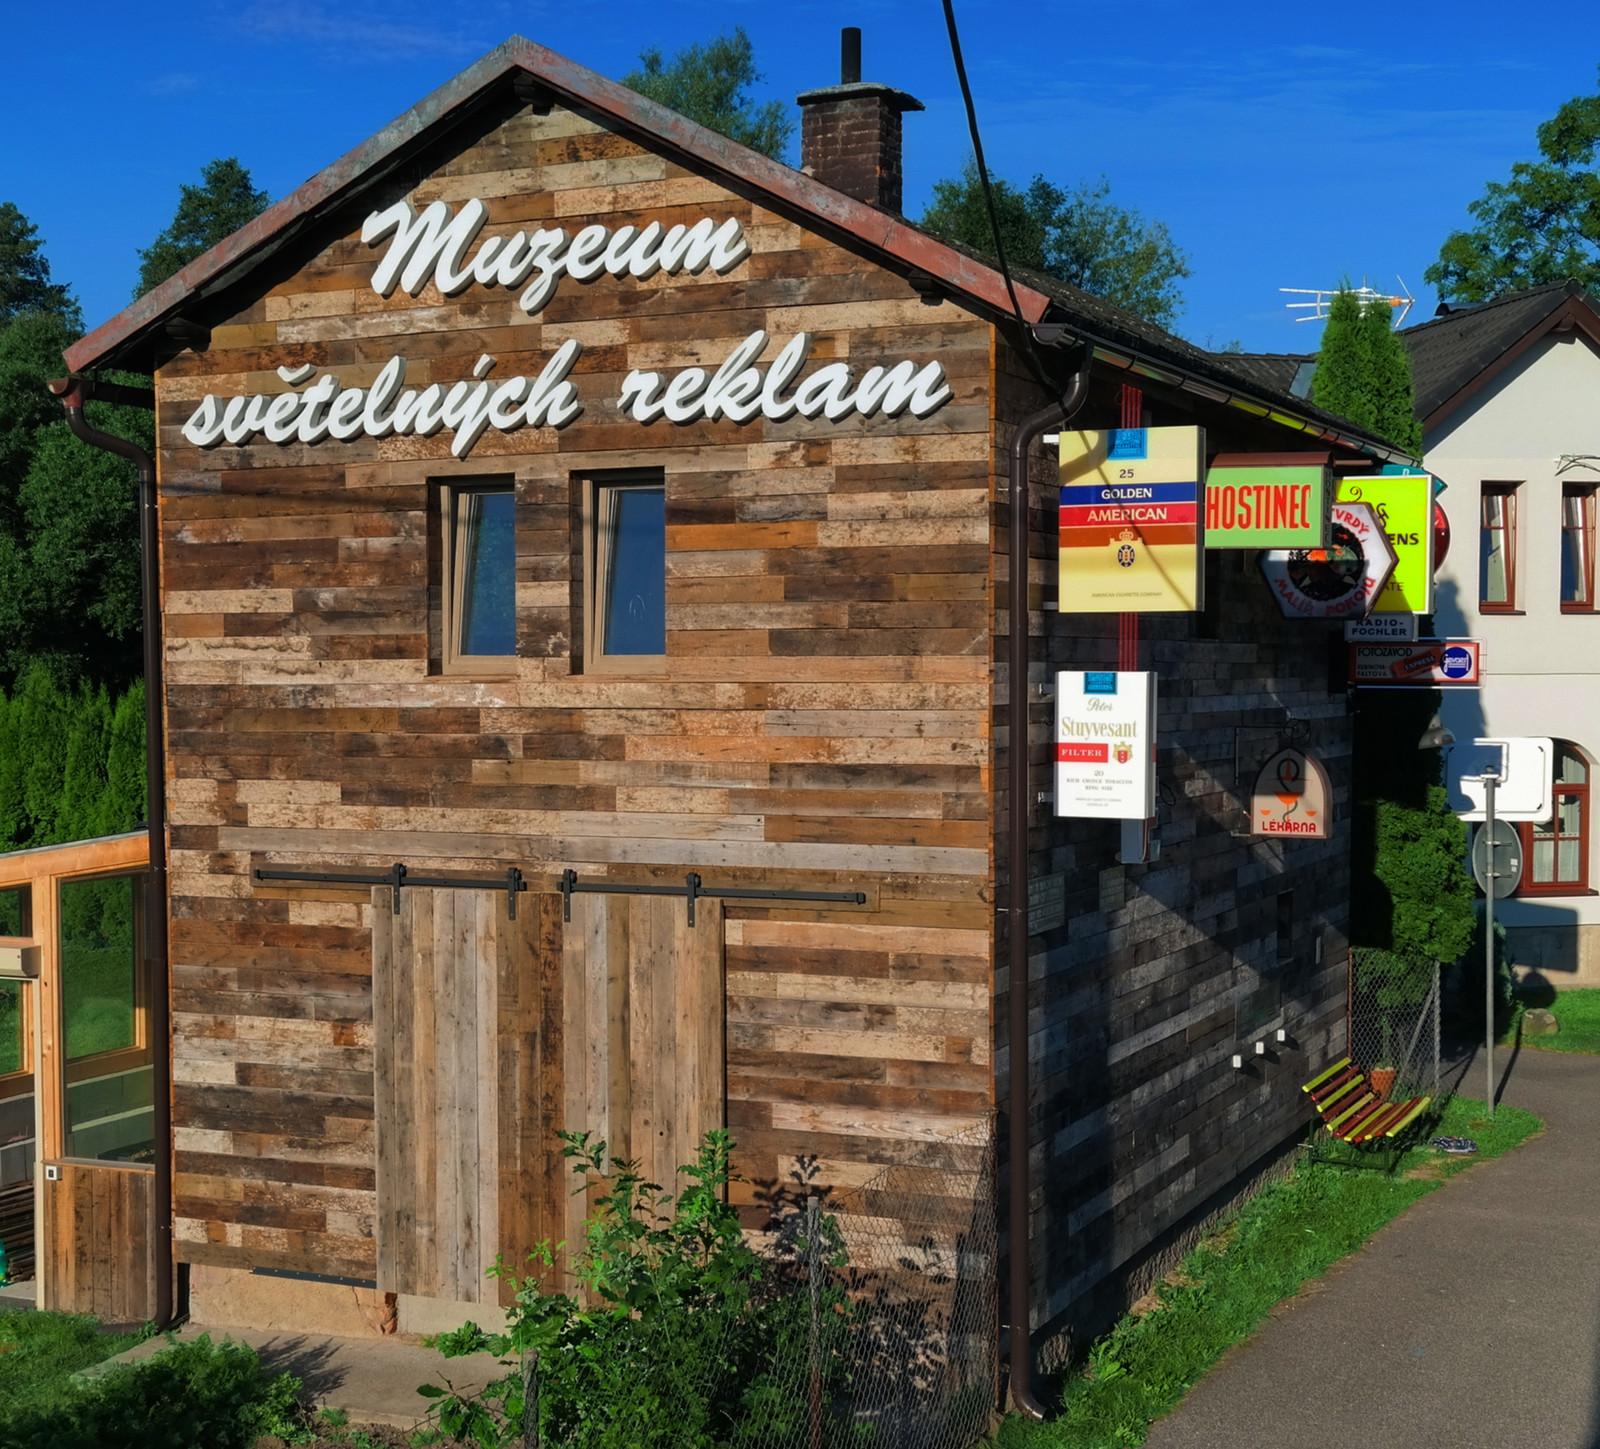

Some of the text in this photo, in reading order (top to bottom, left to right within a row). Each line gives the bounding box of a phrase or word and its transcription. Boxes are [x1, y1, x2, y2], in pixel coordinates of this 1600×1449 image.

[361, 197, 751, 313] Muzeum
[181, 328, 955, 459] světelných reklam
[1119, 469, 1134, 479] 25
[1101, 488, 1153, 500] GOLDEN
[1087, 508, 1168, 522] AMERICAN
[1205, 484, 1312, 531] HOSTINEC
[1352, 628, 1407, 636] FOCHLER
[1086, 697, 1114, 712] Peter
[1061, 716, 1138, 741] Stuyvesant
[1061, 749, 1103, 757] FILTER
[1261, 818, 1317, 833] LÉKÁRNA
